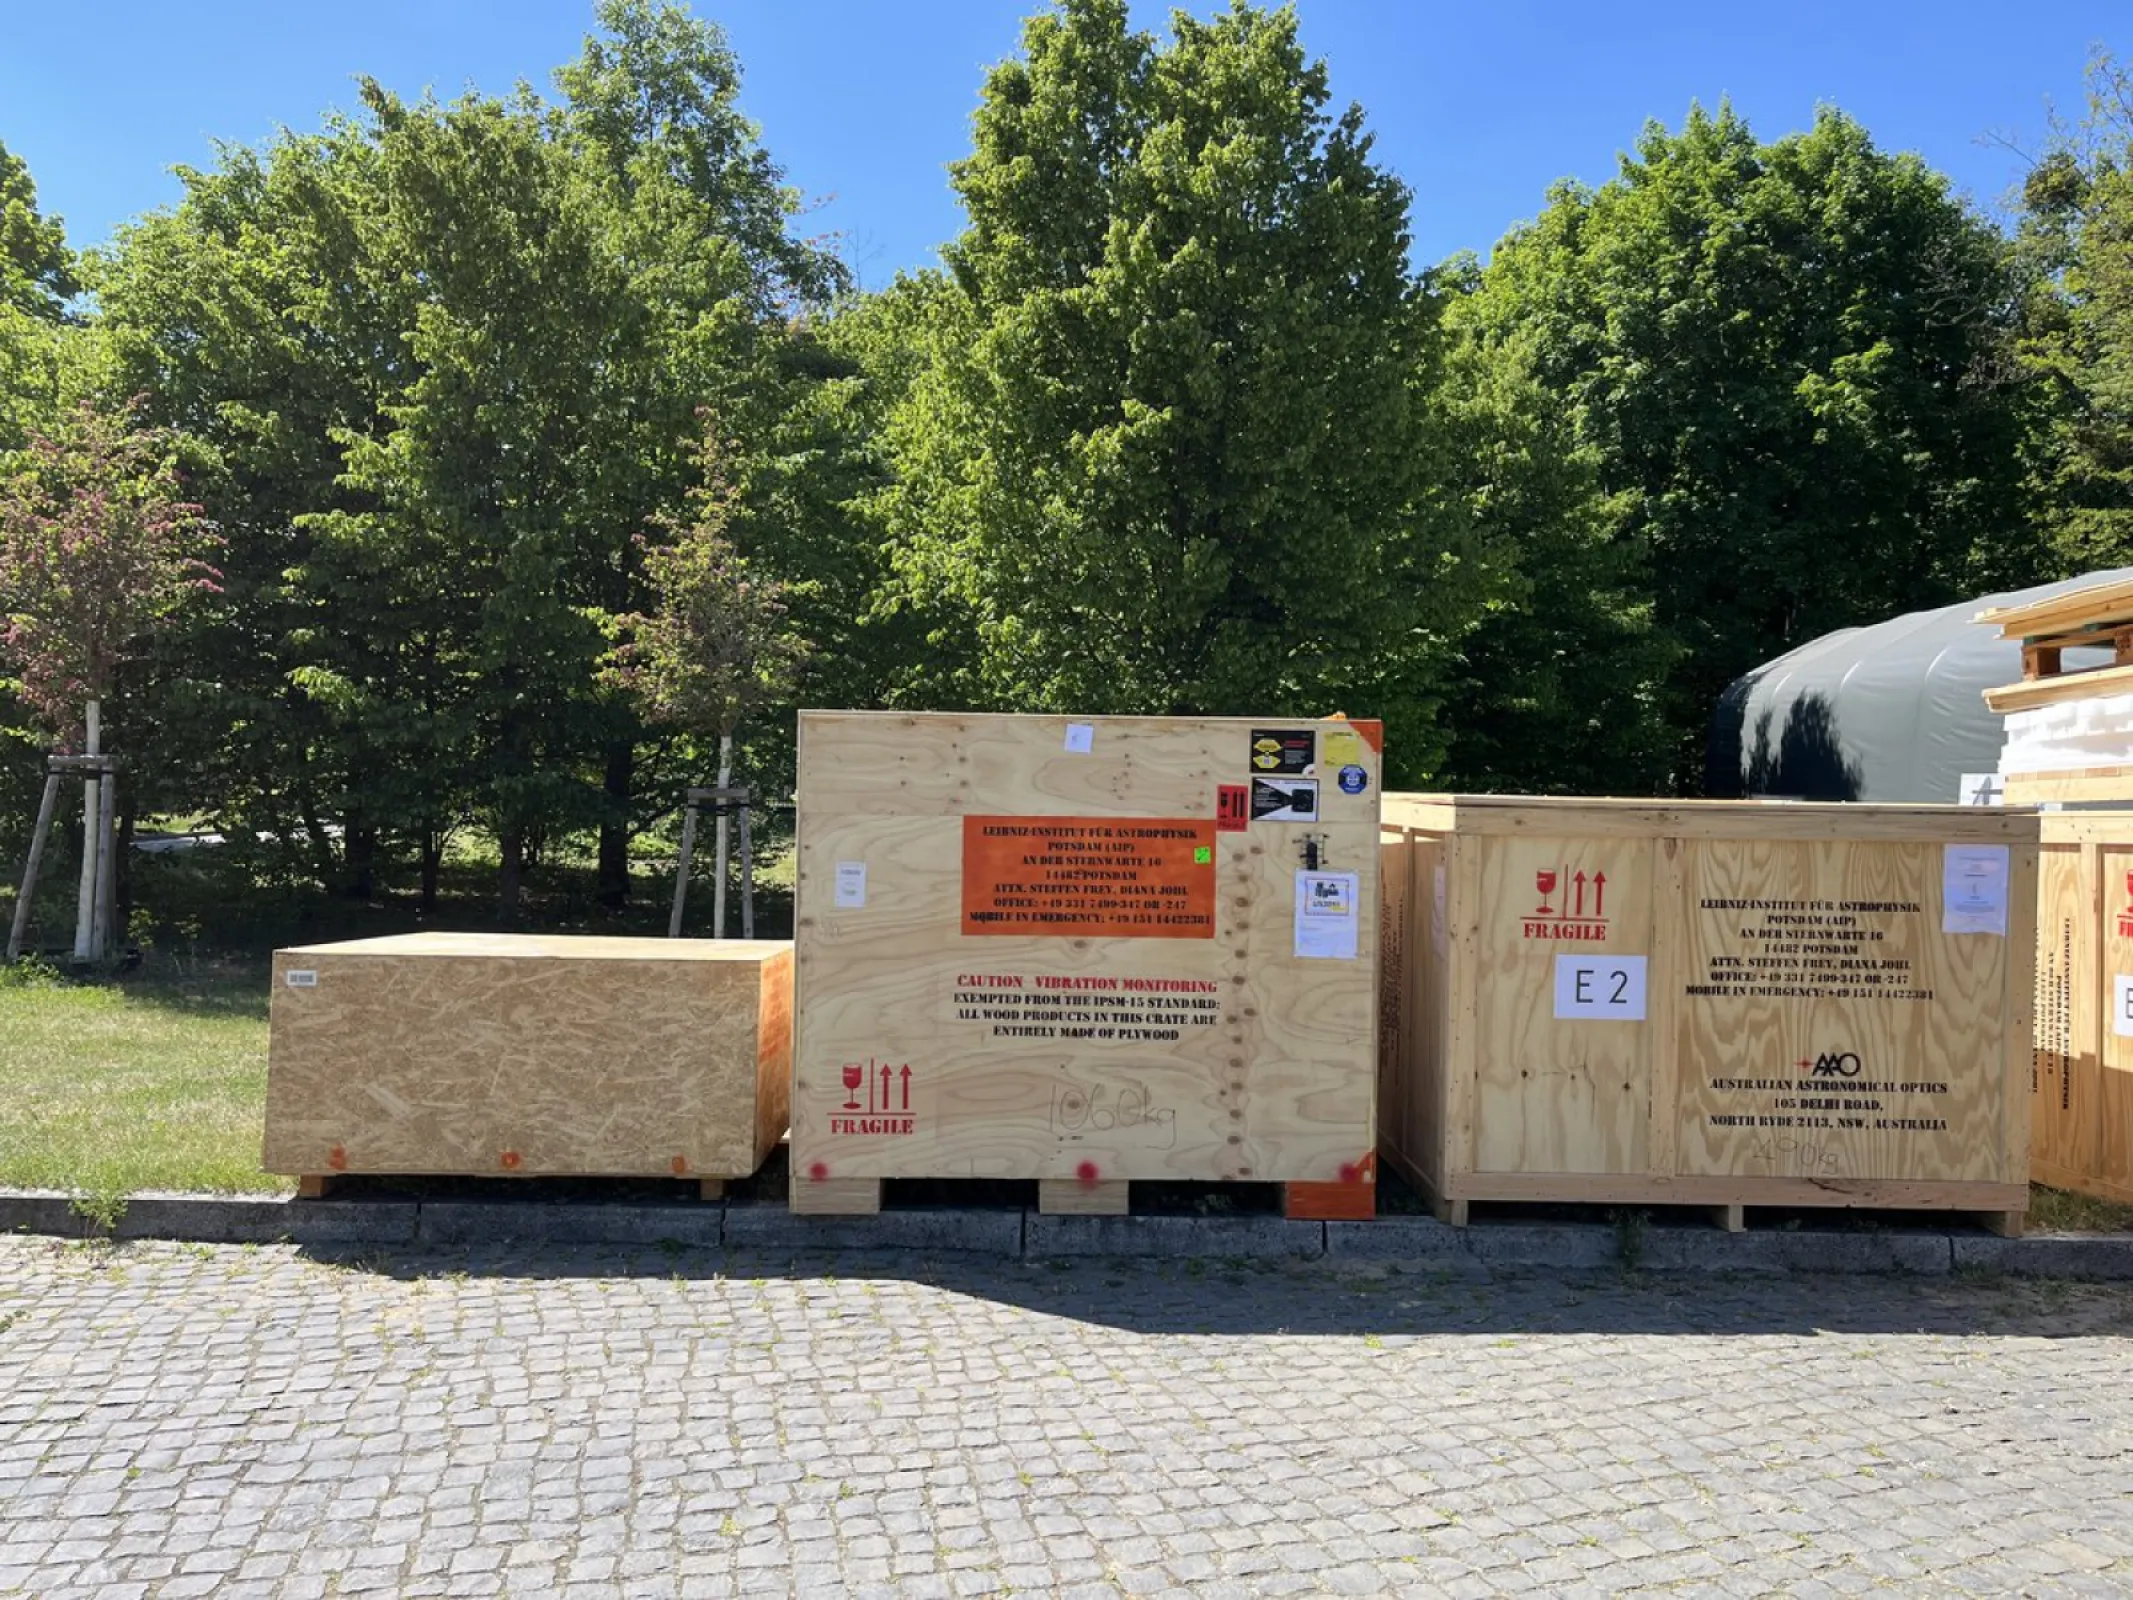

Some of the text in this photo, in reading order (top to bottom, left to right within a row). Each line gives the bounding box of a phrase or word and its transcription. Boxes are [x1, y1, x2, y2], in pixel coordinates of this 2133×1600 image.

[1115, 828, 1198, 840] ASTROPHYSIK
[1047, 841, 1103, 852] POTSDAM
[1022, 855, 1038, 866] AN
[1039, 856, 1064, 866] DER
[1065, 856, 1146, 867] STERNWARTE
[1083, 870, 1137, 881] POTSDAM
[1029, 884, 1081, 895] STEFFEN
[1119, 885, 1156, 896] DIANA
[993, 898, 1039, 909] OFFICE:
[1143, 900, 1160, 910] OR
[1838, 901, 1920, 913] ASTROPHYSIK
[969, 911, 1014, 923] MOBILE
[1016, 912, 1029, 922] IN
[1032, 912, 1105, 924] EMERGENCY:
[1766, 915, 1824, 926] POTSDAM
[1523, 923, 1606, 941] FRAGILE
[1739, 928, 1756, 939] AN
[1758, 929, 1782, 940] DER
[1785, 930, 1866, 941] STERNWARTE
[1802, 944, 1859, 955] POTSDAM
[1747, 957, 1799, 969] STEFFEN
[1840, 959, 1878, 970] DIANA
[957, 974, 1218, 993] CAUTION VIBRATION MONITORING
[1710, 971, 1758, 982] OFFICE:
[1864, 973, 1882, 984] OR
[1685, 985, 1731, 996] MOBILE
[1732, 986, 1748, 997] IN
[1750, 986, 1825, 998] EMERGENCY:
[953, 993, 1022, 1005] EXEMPTED
[1024, 994, 1060, 1006] FROM
[1063, 995, 1091, 1006] THE
[956, 1008, 1217, 1026] ALL WOOD PRODUCTS IN THIS CRATE ARE
[993, 1026, 1179, 1041] ENTIRELY MADE OF PLYWOOD
[1709, 1078, 1948, 1094] AUSTRALIAN ASTRONOMICAL OPTICS
[1774, 1097, 1884, 1112] 105 DELHI ROAD,
[830, 1118, 914, 1135] FRAGILE
[1709, 1115, 1756, 1127] NORTH
[1759, 1115, 1794, 1128] RYDE
[1837, 1117, 1869, 1130] NSW,
[1872, 1118, 1948, 1131] AUSTRALIA
